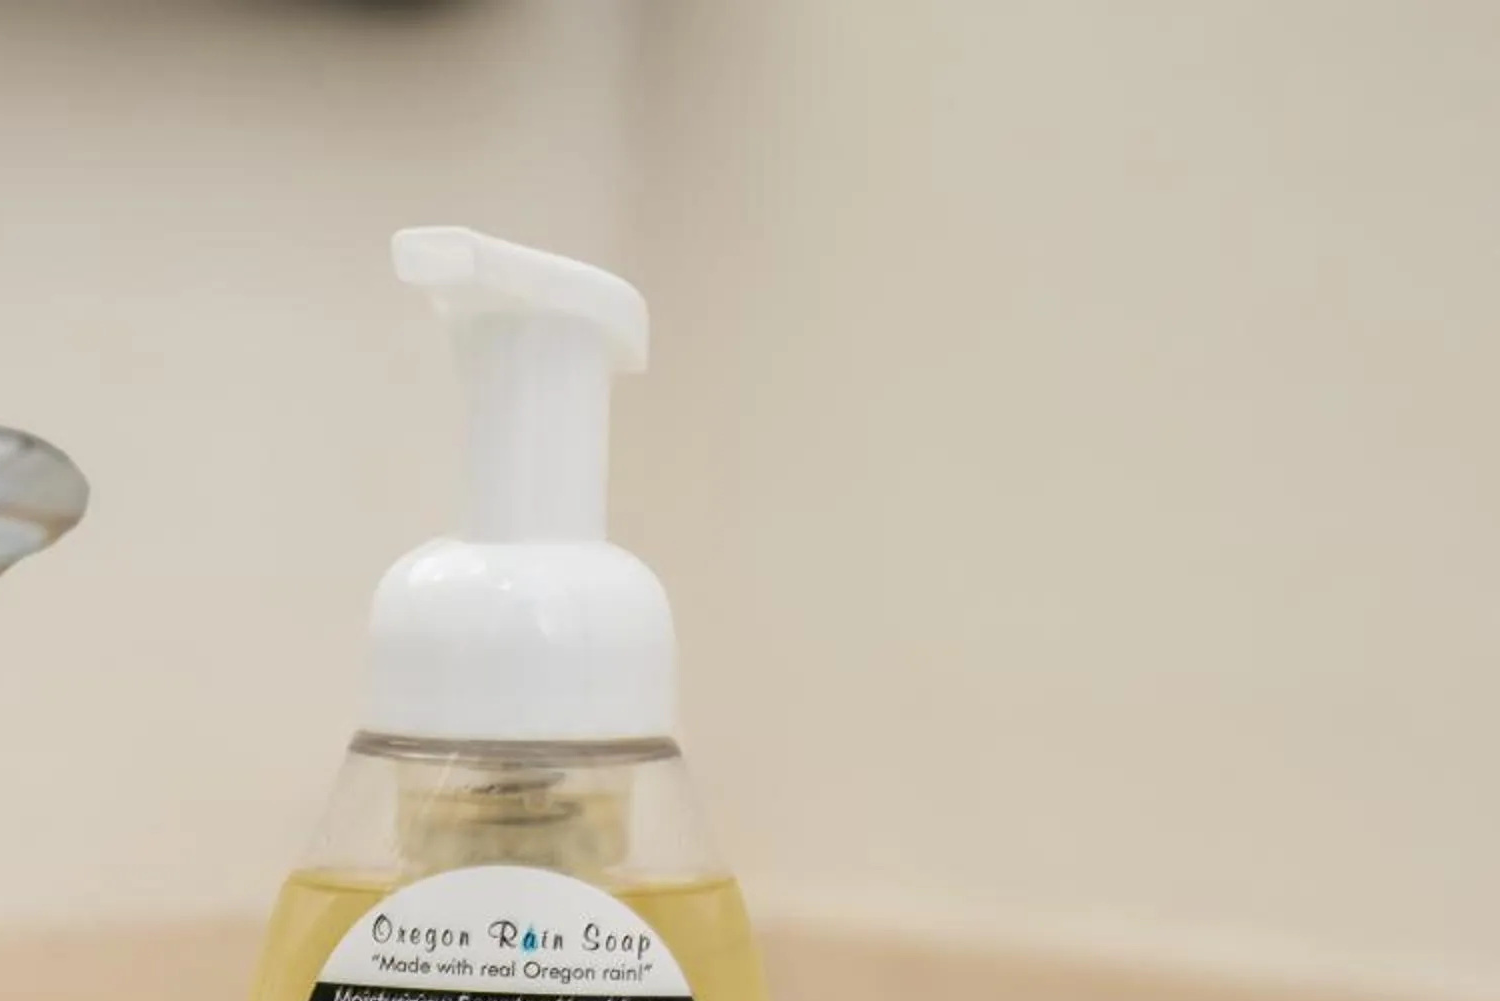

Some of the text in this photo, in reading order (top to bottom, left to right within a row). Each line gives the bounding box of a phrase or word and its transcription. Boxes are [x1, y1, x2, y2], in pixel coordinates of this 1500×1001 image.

[372, 913, 651, 959] Oregon Rain Soap
[437, 957, 473, 977] with
[480, 961, 515, 978] real
[524, 962, 597, 984] Oregon
